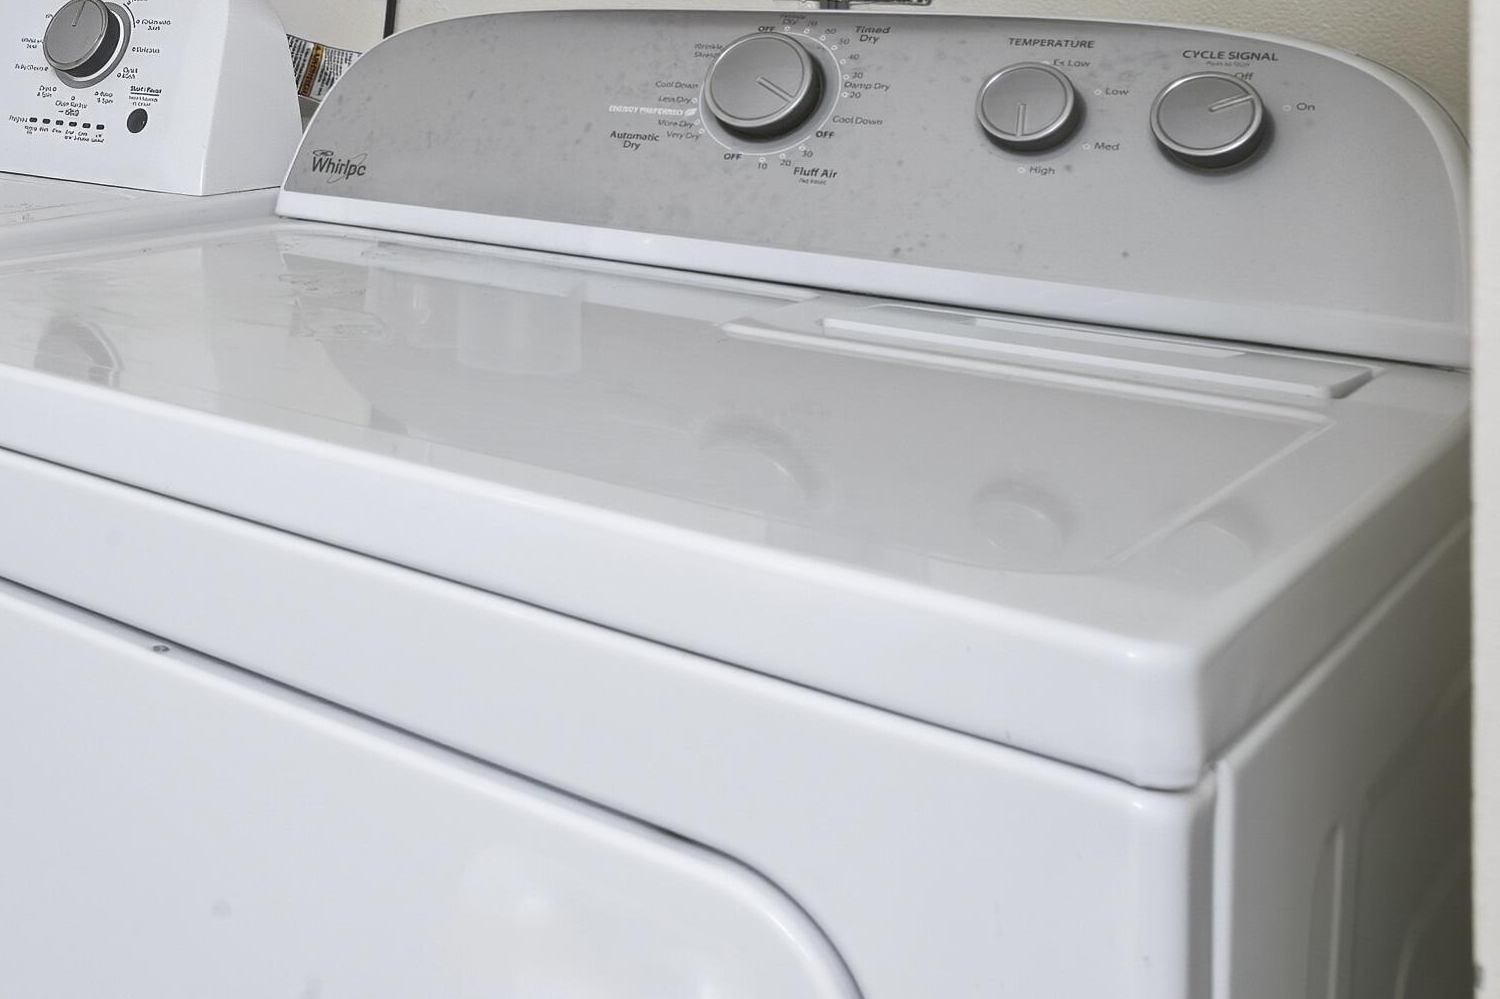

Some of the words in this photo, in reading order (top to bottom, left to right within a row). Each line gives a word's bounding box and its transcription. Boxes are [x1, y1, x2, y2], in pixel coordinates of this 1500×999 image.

[855, 25, 891, 34] Timed
[860, 34, 880, 44] Dry
[1008, 37, 1096, 49] TEMPERATURE
[1182, 50, 1226, 59] CYCLE
[1228, 51, 1279, 62] SIGNAL
[1067, 59, 1091, 67] Low
[844, 81, 871, 90] Damp
[874, 82, 890, 91] Dry
[1105, 87, 1129, 96] Low
[1296, 102, 1316, 112] On
[833, 115, 853, 125] Cool
[855, 116, 883, 125] Down
[609, 130, 660, 142] Automatic
[666, 131, 684, 140] Very
[685, 132, 701, 141] Dry
[815, 130, 835, 139] OFF
[623, 140, 641, 150] Dry
[1093, 142, 1120, 151] Med
[758, 162, 768, 170] 10
[780, 159, 791, 167] 20
[794, 166, 819, 177] Fluff
[820, 169, 838, 179] Air
[1029, 166, 1056, 176] High
